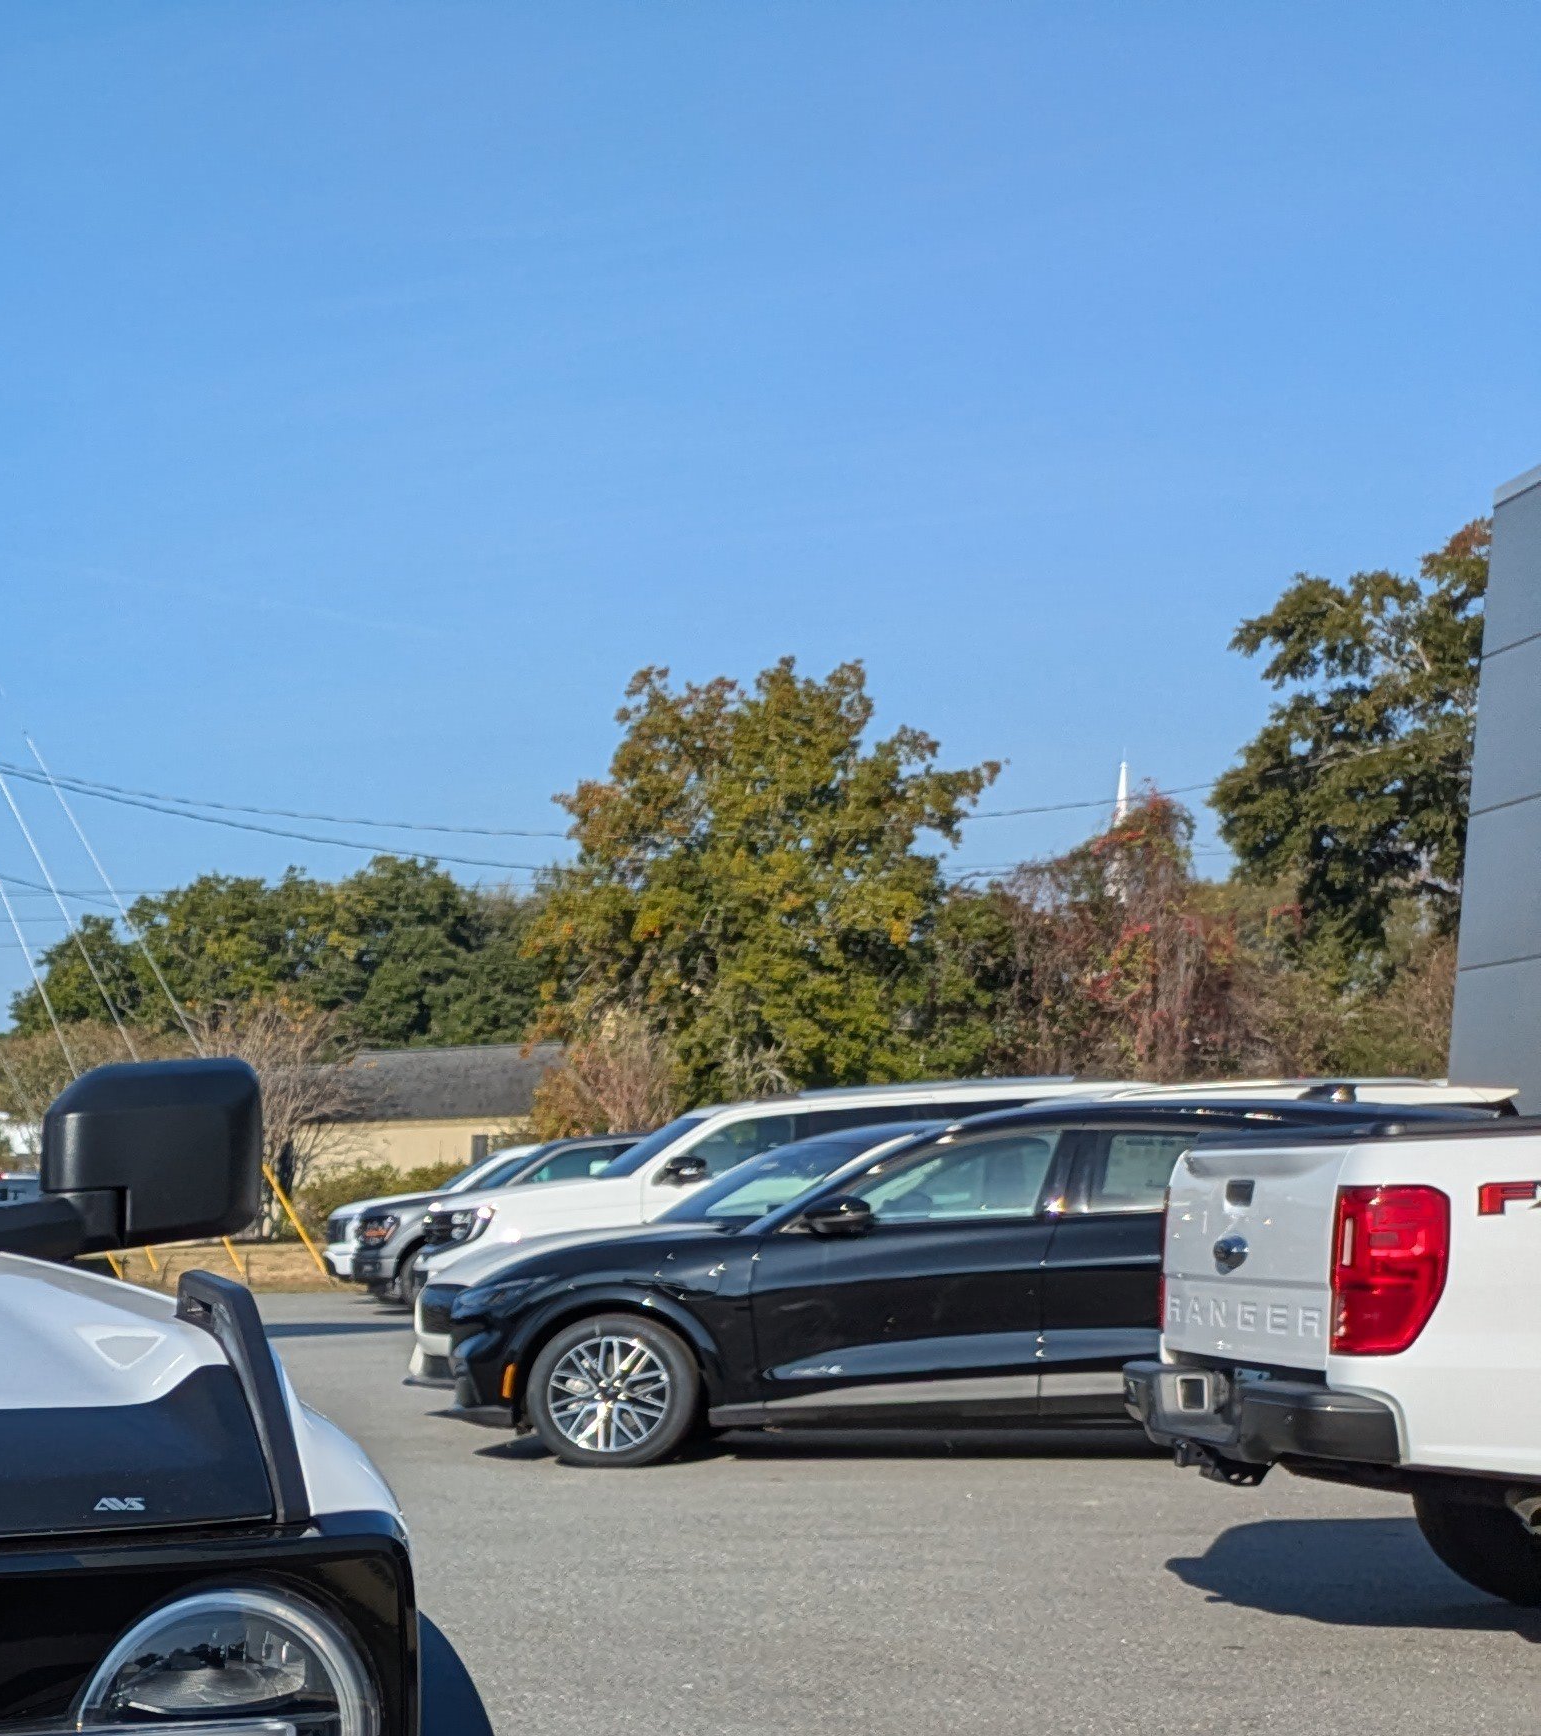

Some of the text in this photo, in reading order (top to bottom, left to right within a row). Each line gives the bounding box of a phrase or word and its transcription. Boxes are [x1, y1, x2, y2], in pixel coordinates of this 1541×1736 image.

[1478, 1181, 1541, 1216] F
[1166, 1295, 1323, 1338] RANGER
[93, 1497, 146, 1511] AVS
